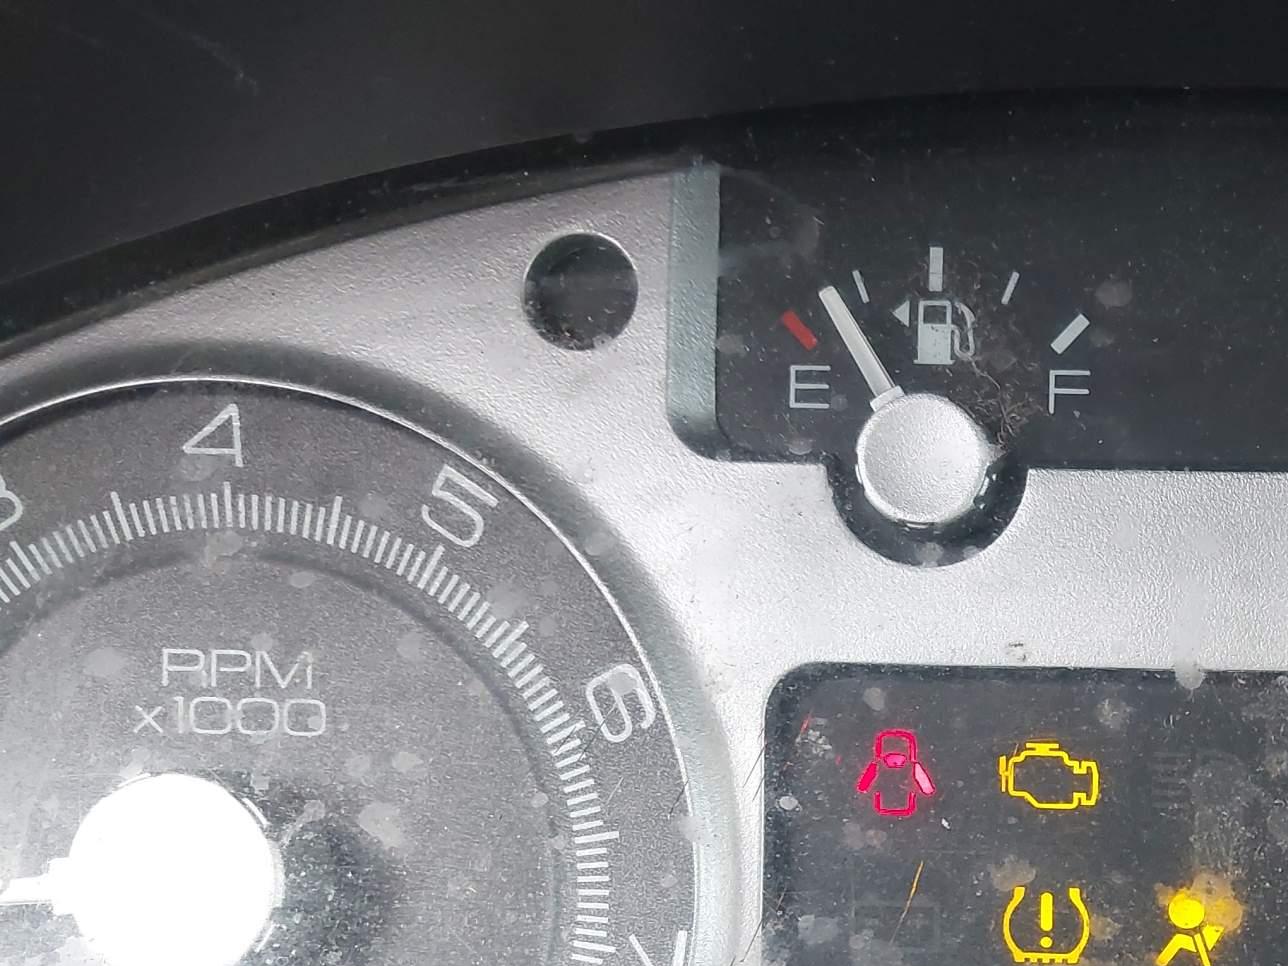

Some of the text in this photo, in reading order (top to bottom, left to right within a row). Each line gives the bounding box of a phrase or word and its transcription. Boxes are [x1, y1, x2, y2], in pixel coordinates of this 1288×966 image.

[789, 364, 831, 409] E
[1049, 369, 1091, 414] F
[182, 403, 244, 468] 4
[421, 464, 499, 548] 5
[161, 648, 313, 690] RPM
[133, 696, 328, 738] x1000
[584, 662, 656, 744] 6
